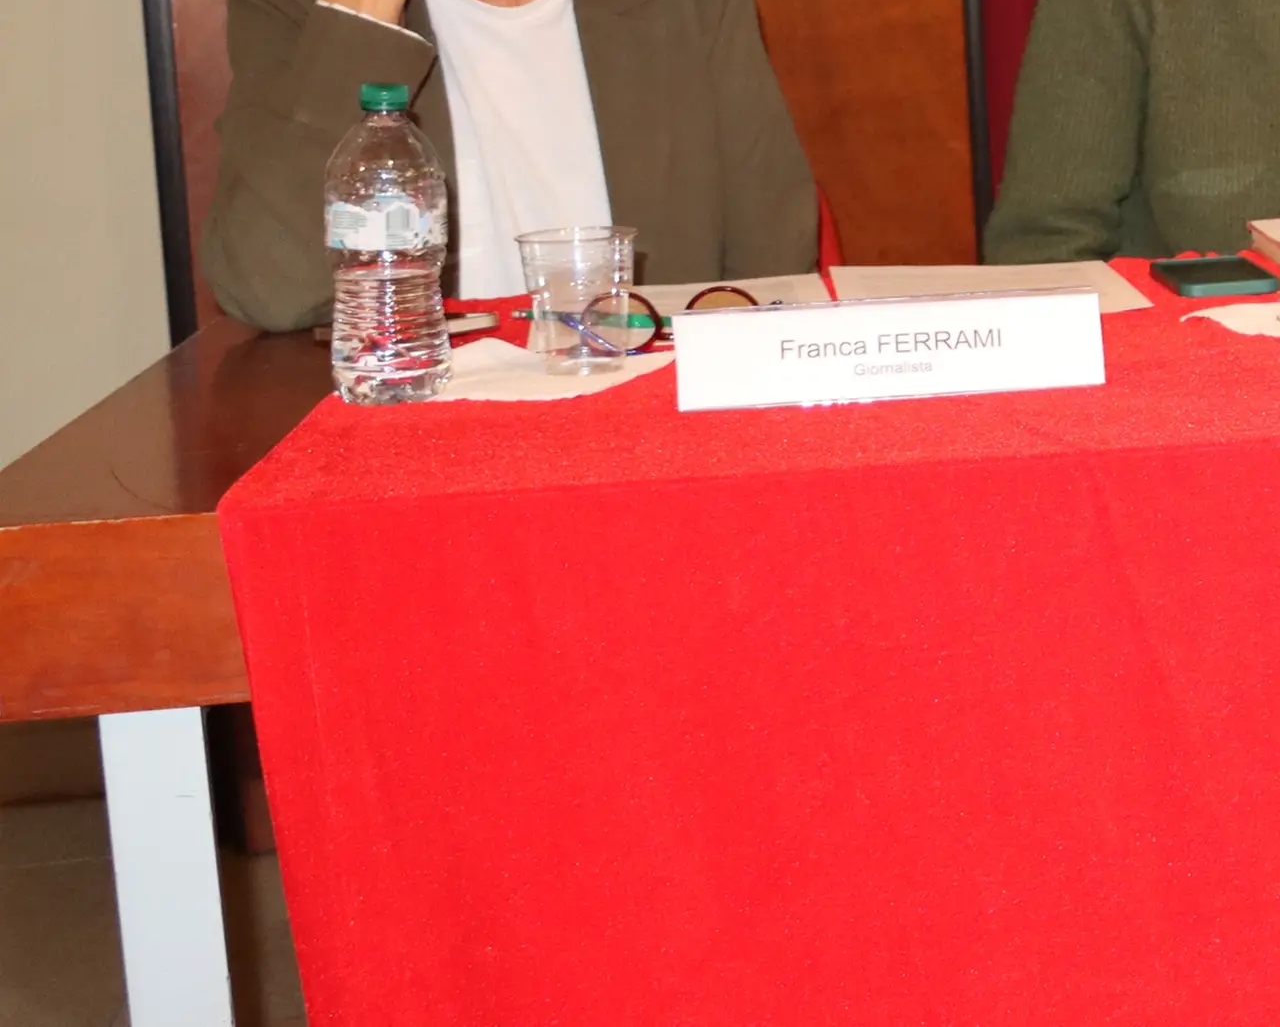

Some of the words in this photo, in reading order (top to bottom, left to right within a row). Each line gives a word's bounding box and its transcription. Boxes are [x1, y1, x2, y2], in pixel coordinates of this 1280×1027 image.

[780, 339, 868, 360] Franca
[877, 328, 1002, 355] FERRAMI
[853, 360, 933, 376] Giornalista
